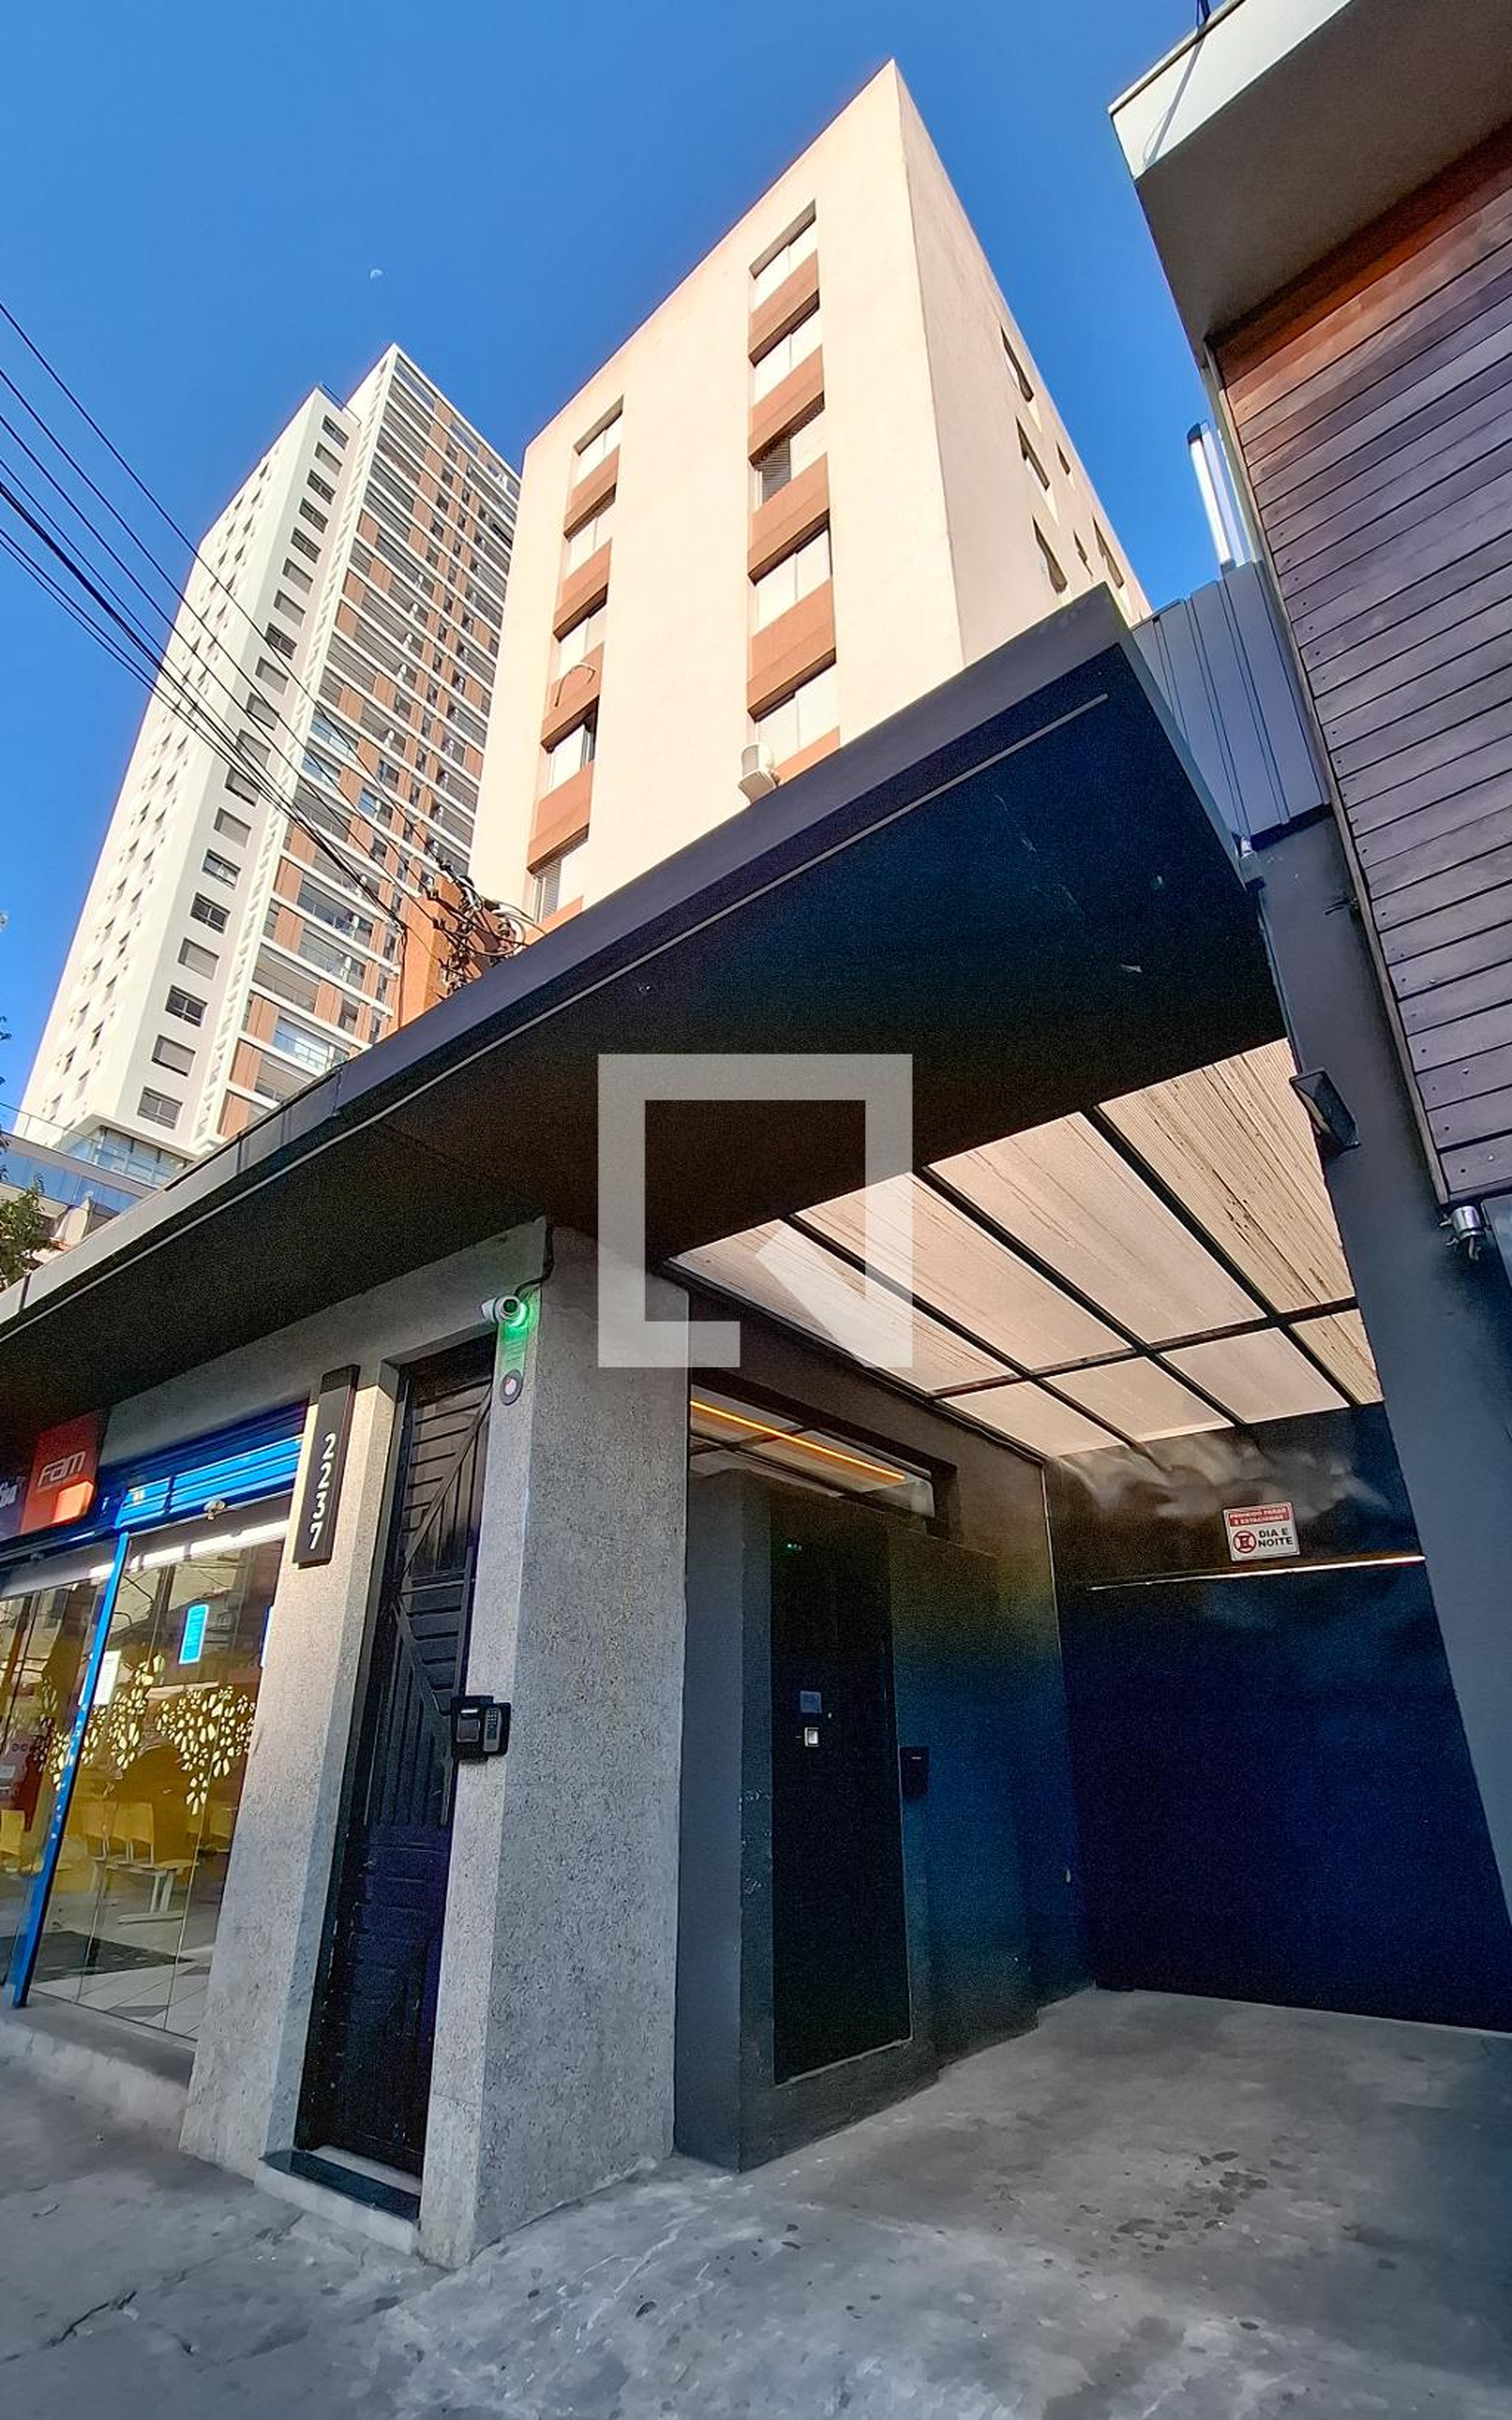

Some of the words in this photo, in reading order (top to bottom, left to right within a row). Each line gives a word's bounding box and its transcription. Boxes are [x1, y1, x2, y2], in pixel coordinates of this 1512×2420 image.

[309, 1433, 336, 1550] 2237
[1259, 1529, 1279, 1538] DIA
[1258, 1536, 1293, 1547] NOITE
